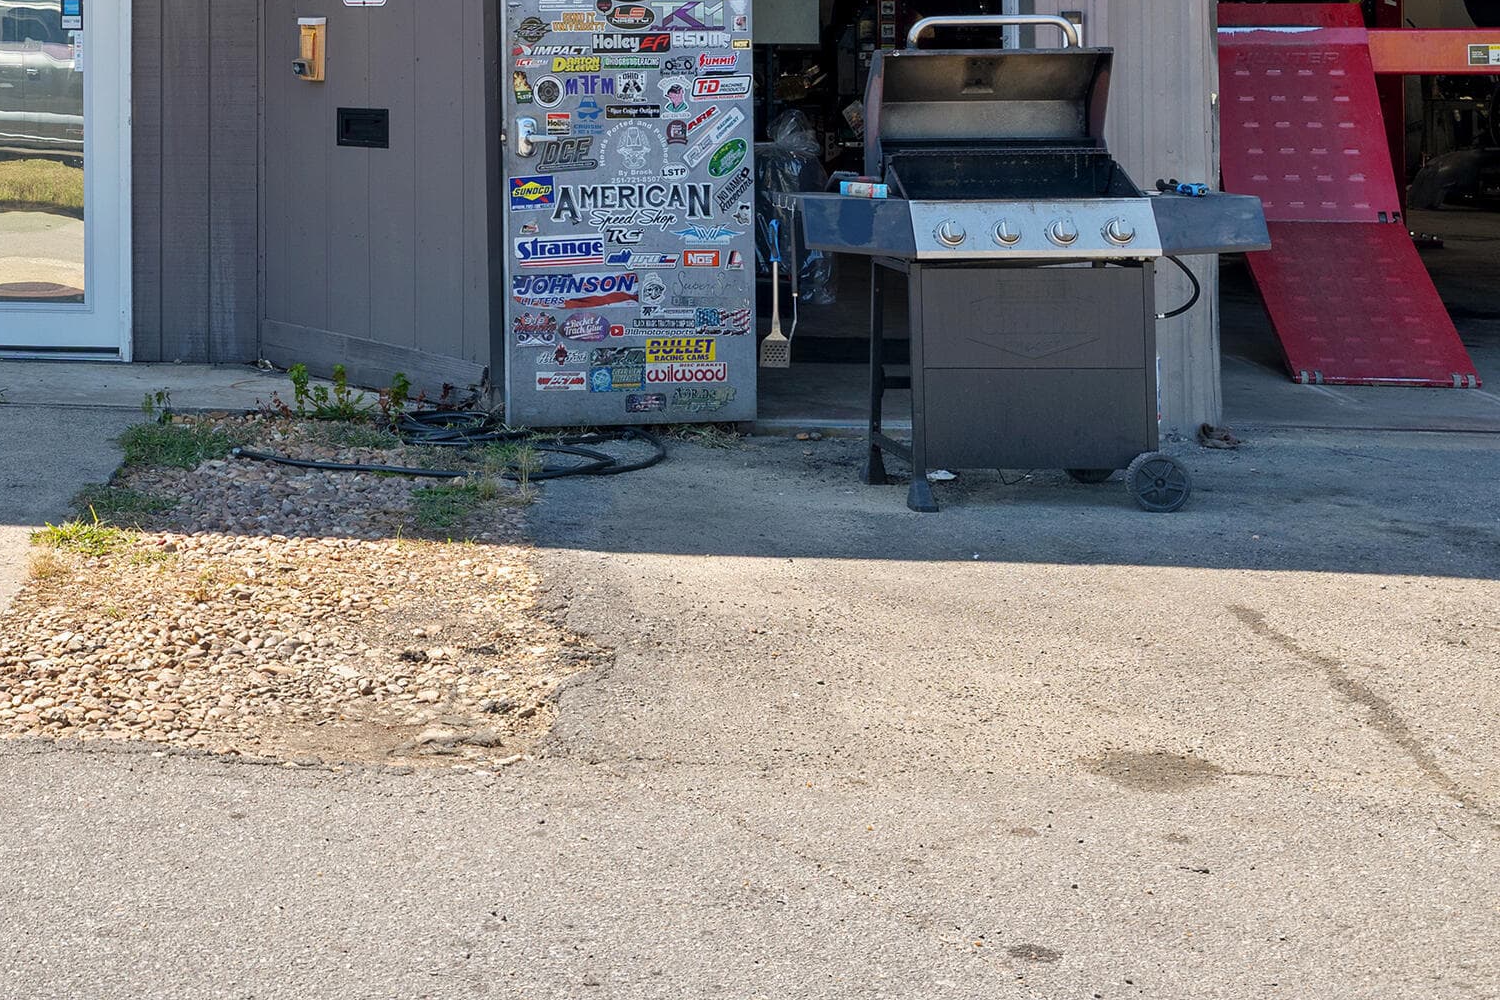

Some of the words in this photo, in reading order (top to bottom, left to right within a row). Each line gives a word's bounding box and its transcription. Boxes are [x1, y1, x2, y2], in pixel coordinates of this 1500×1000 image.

[533, 45, 590, 55] IMPACT
[592, 33, 640, 52] Holley
[639, 34, 670, 51] EFI
[607, 119, 634, 137] Ported
[637, 119, 653, 129] and
[618, 169, 627, 177] By
[662, 168, 686, 177] LSTP
[514, 186, 551, 196] SUNOCO
[553, 184, 712, 220] AMERICAN
[590, 209, 637, 231] Speed
[638, 209, 677, 231] Shop
[517, 238, 603, 260] Strange
[688, 253, 714, 264] NOS
[516, 275, 635, 296] JOHNSON
[520, 296, 565, 306] LIFTERS
[563, 325, 587, 336] Track
[648, 338, 714, 355] BULLET
[647, 363, 727, 382] wilwood
